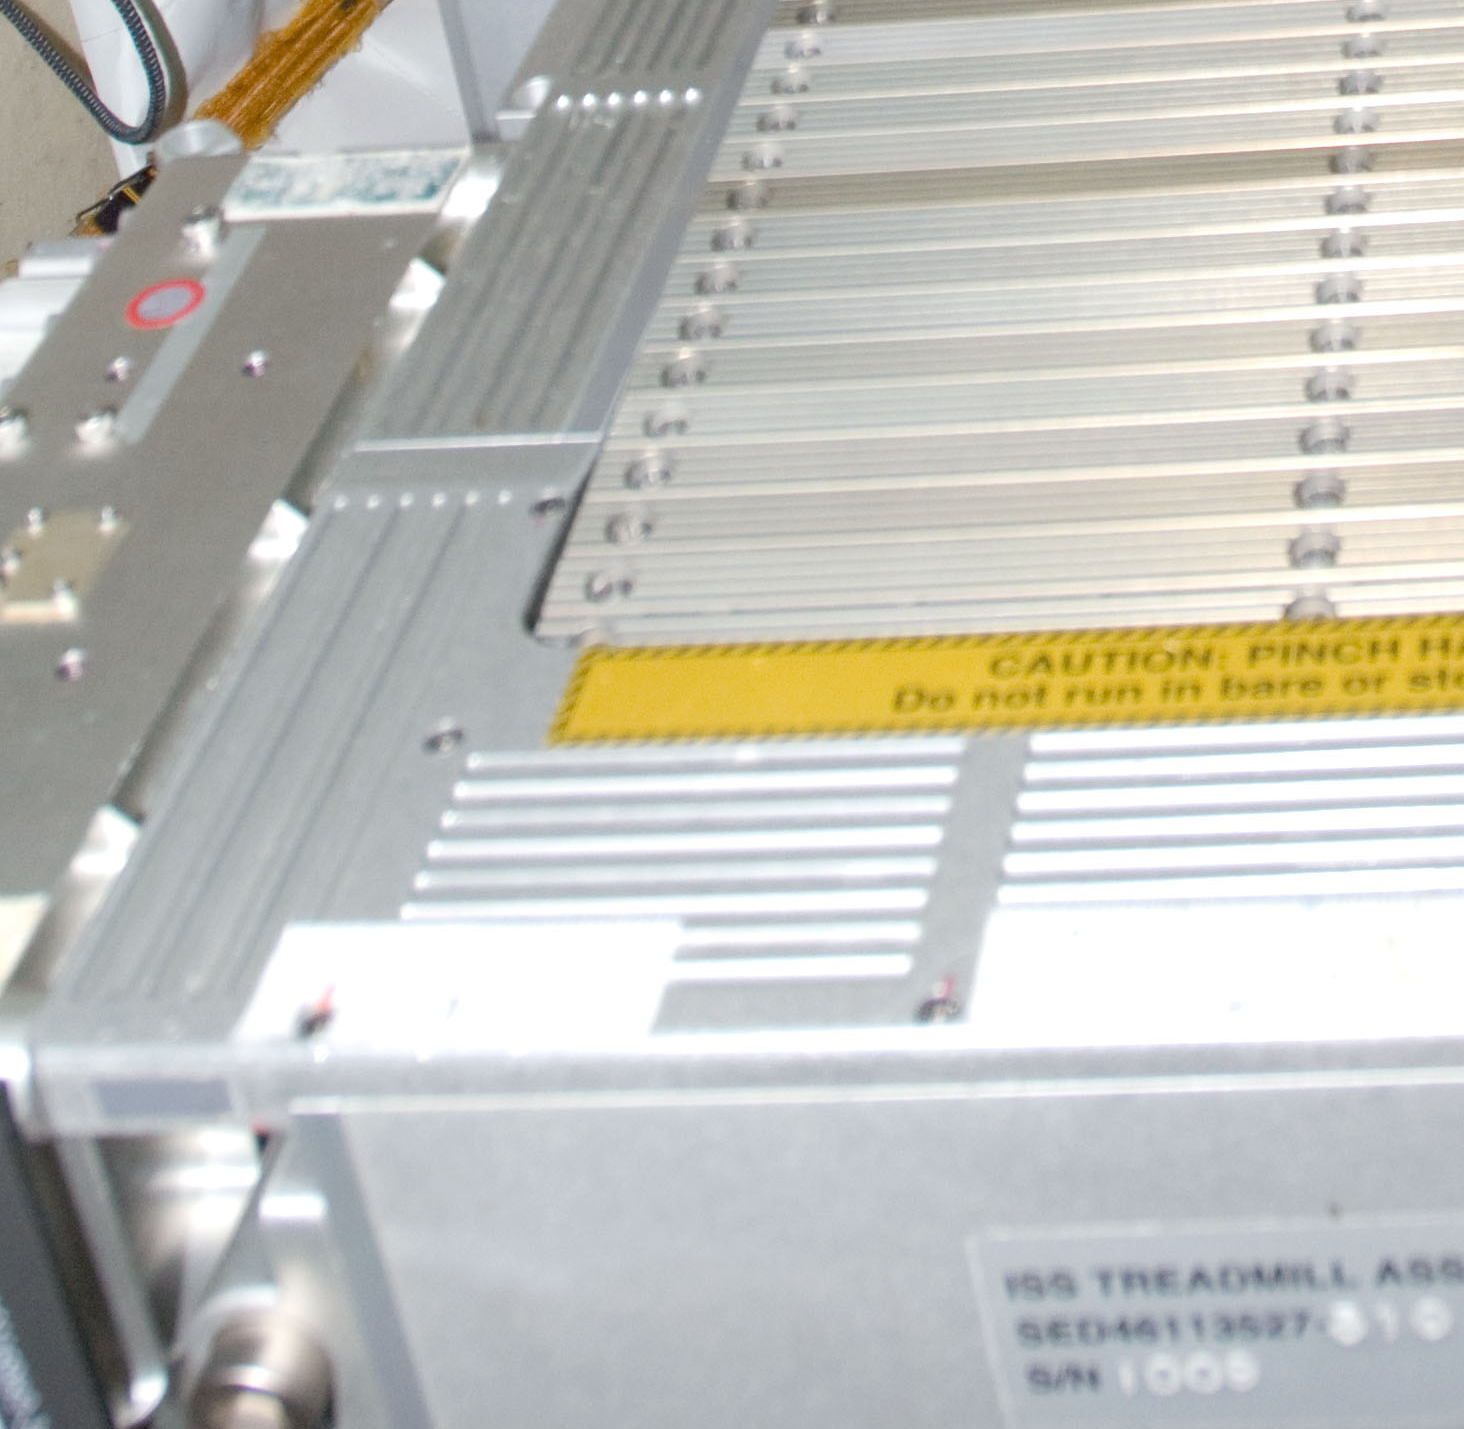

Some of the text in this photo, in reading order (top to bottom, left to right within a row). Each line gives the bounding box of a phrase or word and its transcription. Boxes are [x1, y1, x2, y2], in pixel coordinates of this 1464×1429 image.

[1247, 637, 1401, 669] PINCH
[892, 686, 956, 717] Do
[972, 681, 1048, 711] not
[1064, 682, 1145, 710] run
[1160, 673, 1202, 704] in
[1219, 667, 1325, 701] bare
[1341, 672, 1388, 697] or
[1004, 1265, 1079, 1301] ISS
[1095, 1256, 1360, 1301] TREADMILL
[1026, 1361, 1102, 1397] S/N
